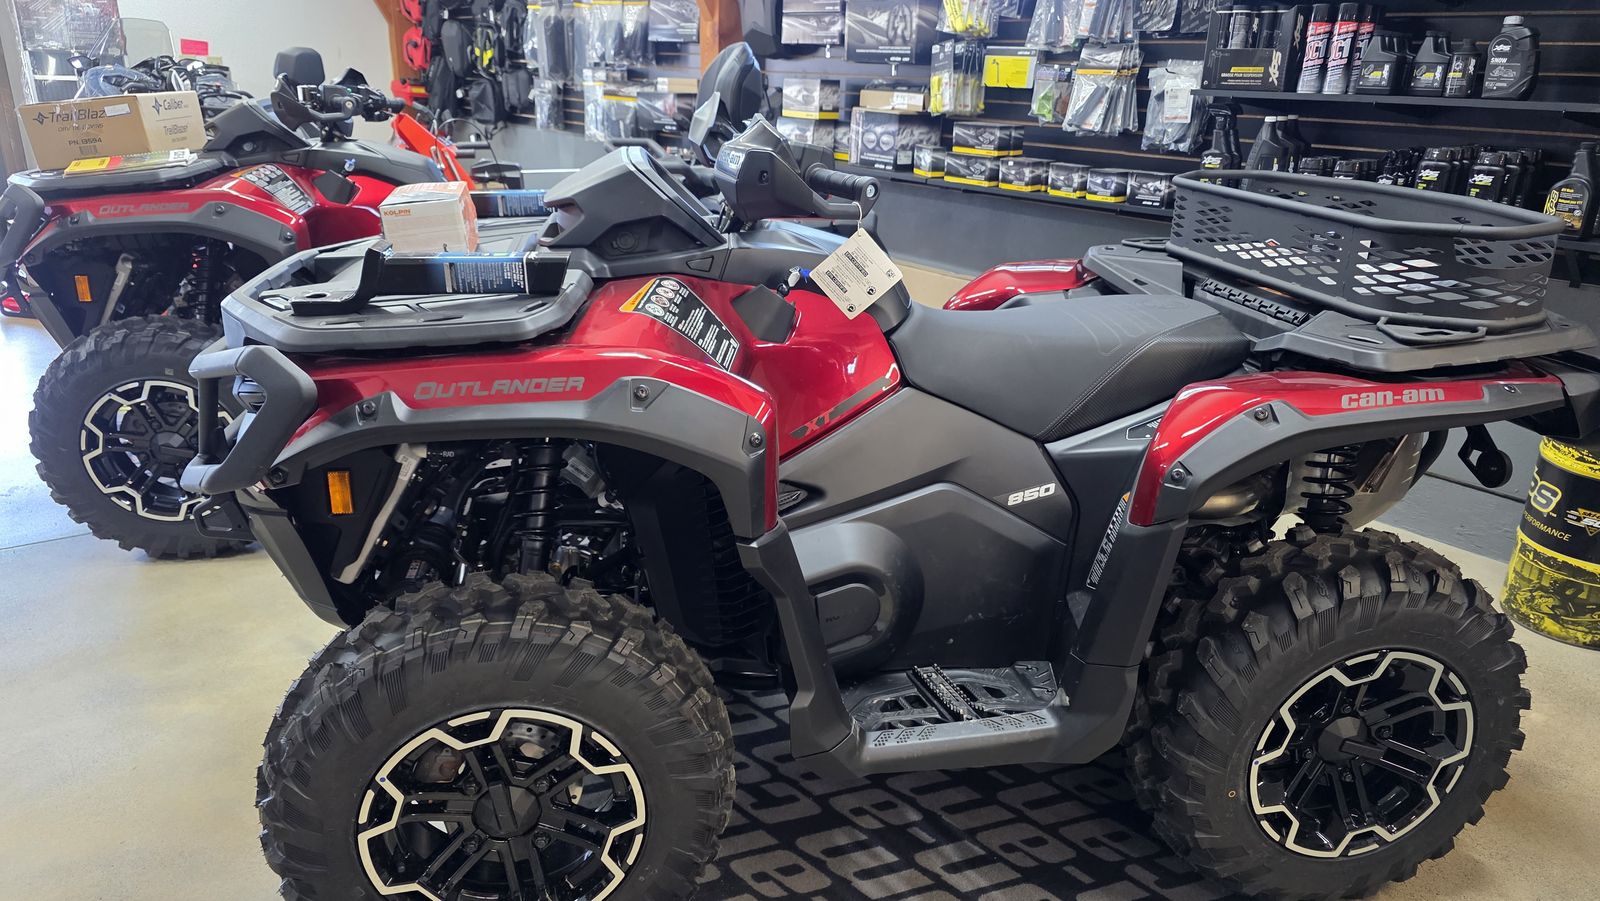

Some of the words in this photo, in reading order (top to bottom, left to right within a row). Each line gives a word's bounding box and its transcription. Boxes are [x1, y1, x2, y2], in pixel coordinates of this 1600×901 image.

[1268, 49, 1282, 87] XPS
[1201, 155, 1223, 164] XPS
[1419, 168, 1441, 178] XPS
[1468, 173, 1496, 183] XPS
[99, 202, 190, 216] OUTLANDER
[383, 208, 411, 217] KOLPIN
[413, 376, 585, 400] OUTLANDER
[1340, 387, 1446, 410] can-am
[804, 408, 834, 437] XT
[1007, 483, 1056, 506] 850
[1524, 511, 1572, 542] PERFORMANCE
